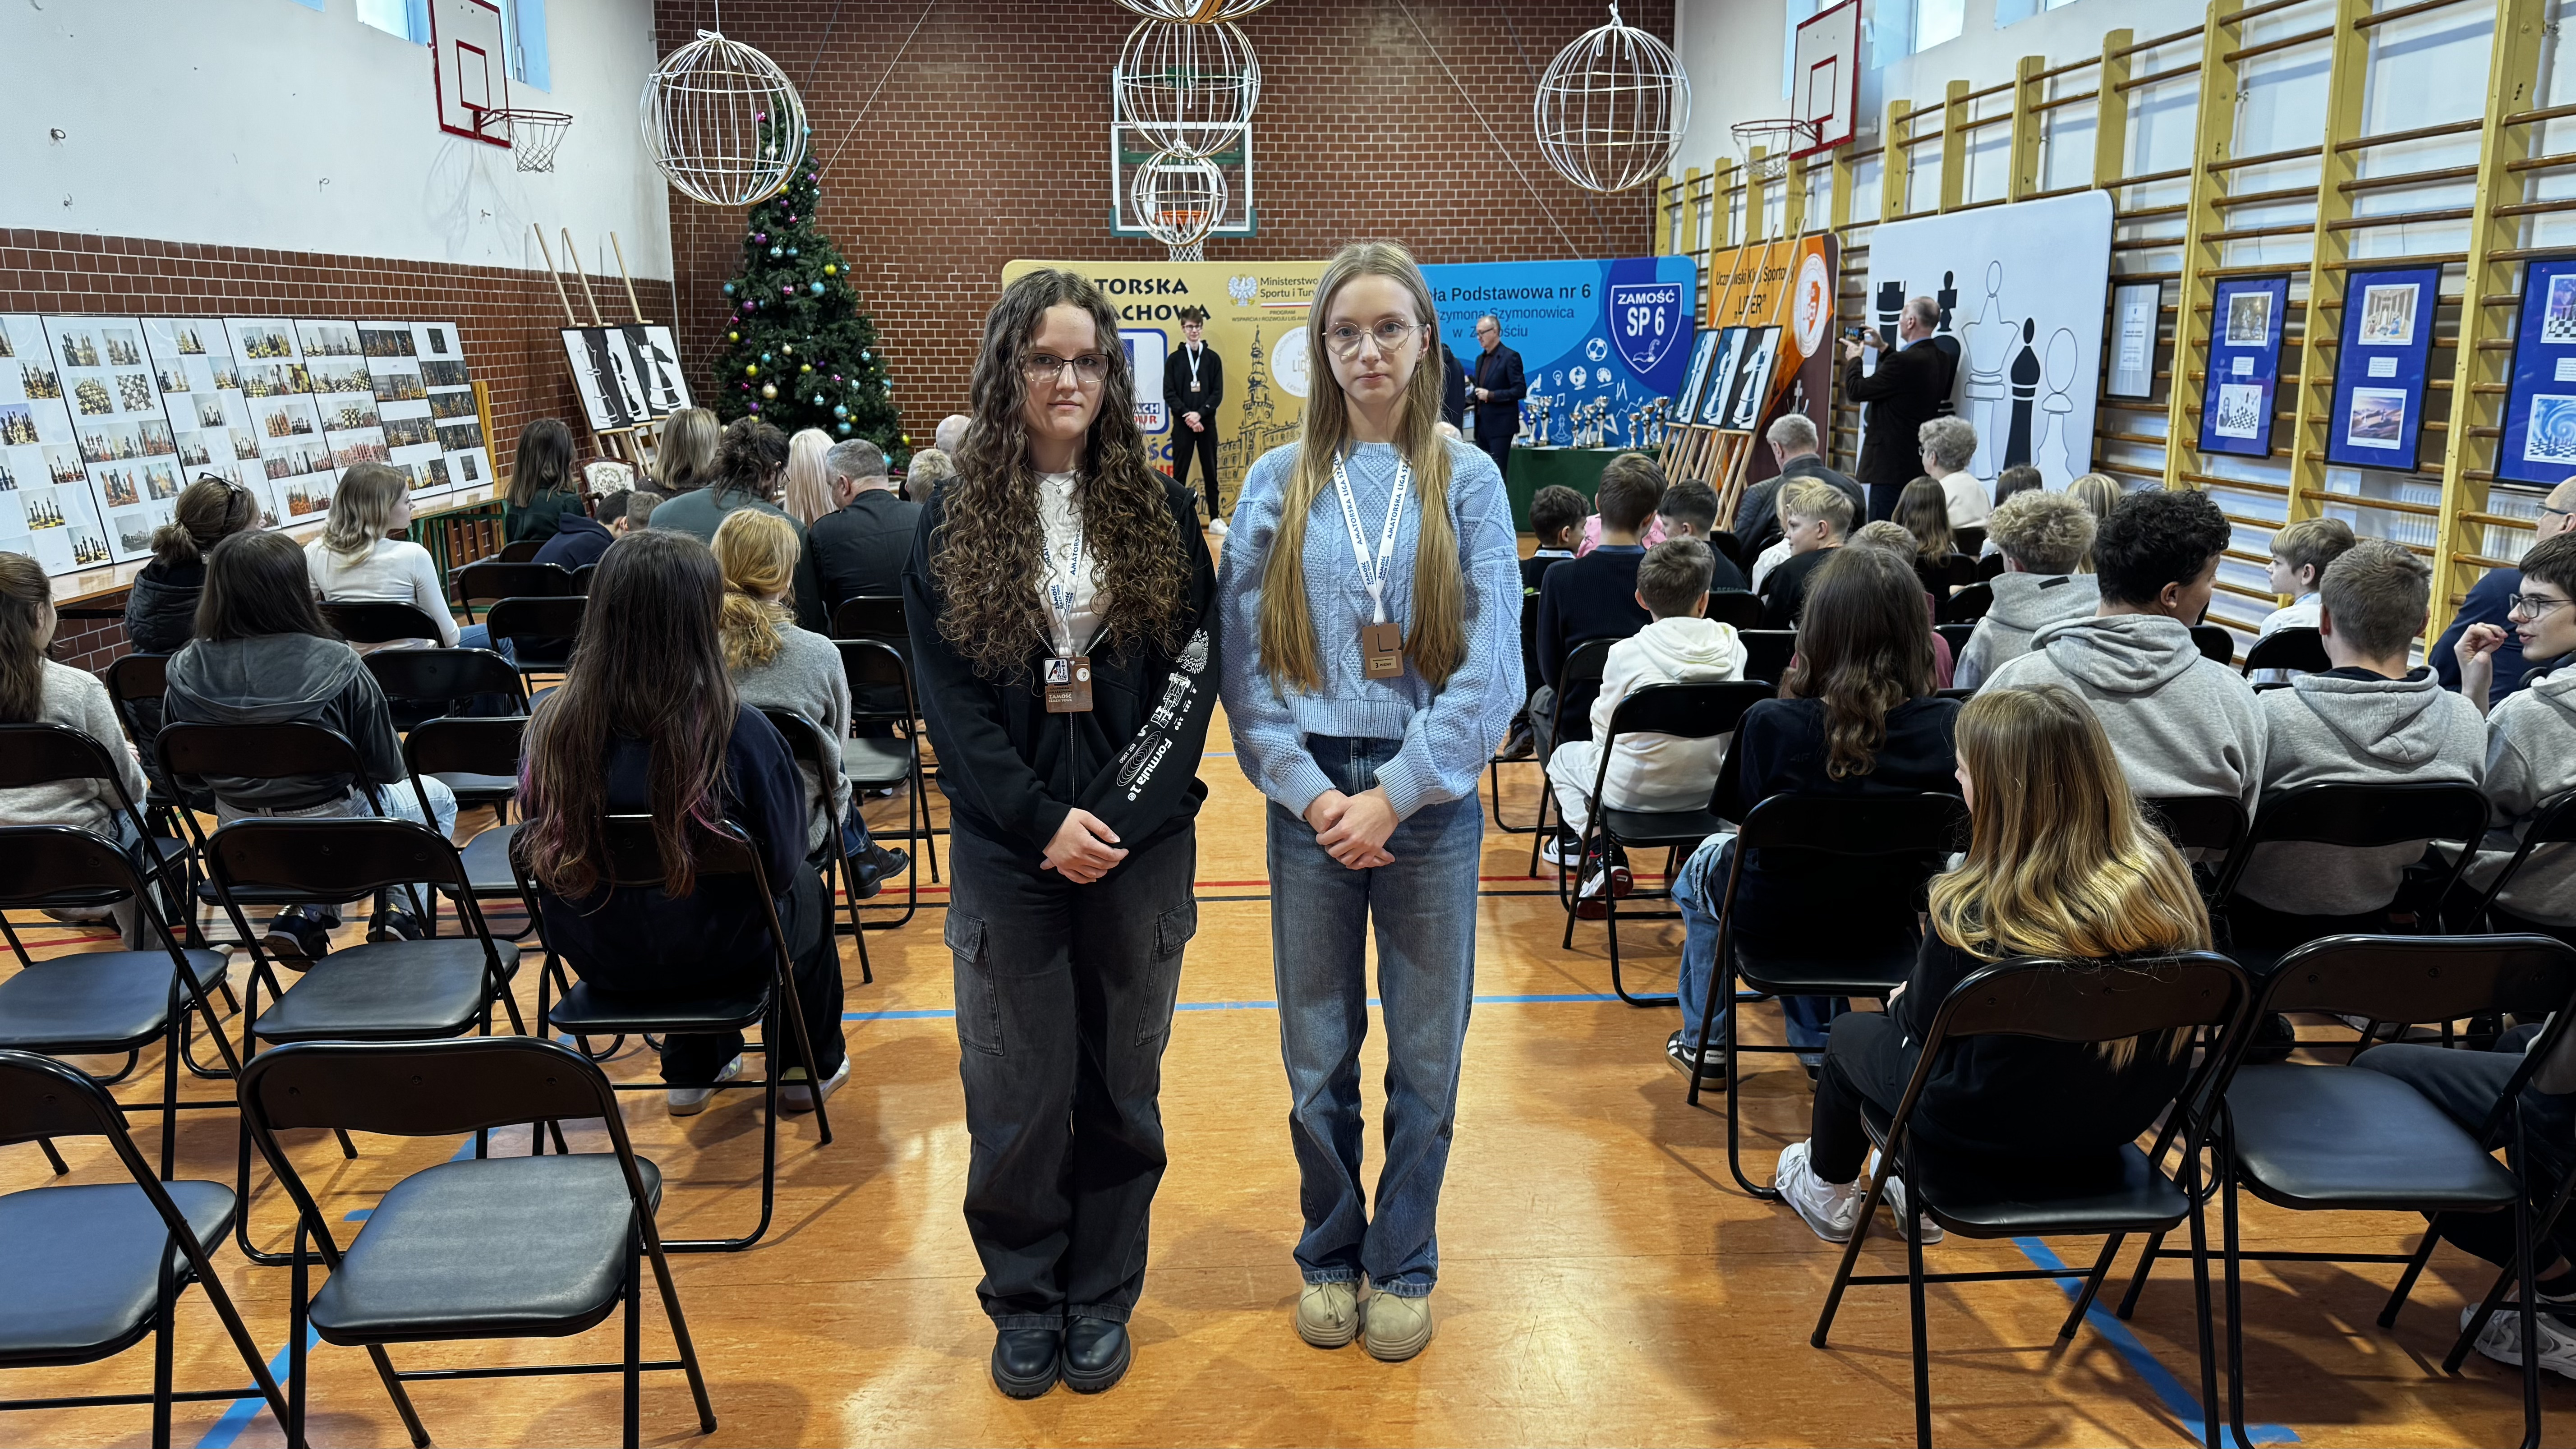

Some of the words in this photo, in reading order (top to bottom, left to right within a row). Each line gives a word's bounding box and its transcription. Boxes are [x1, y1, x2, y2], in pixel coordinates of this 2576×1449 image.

[1094, 277, 1189, 294] TORSKA
[1260, 277, 1318, 286] Ministerstwo
[1260, 289, 1290, 298] Sportu
[1293, 289, 1295, 297] i
[1452, 286, 1554, 301] Podstawowa
[1559, 286, 1576, 299] nr
[1581, 284, 1591, 298] 6
[1617, 289, 1675, 304] ZAMOŚĆ
[1121, 303, 1211, 321] CHOWA
[1490, 307, 1574, 322] Szymonowica
[1626, 307, 1651, 336] SP
[1654, 306, 1665, 336] 6
[1452, 328, 1463, 338] w
[1341, 480, 1349, 496] LIGA
[1387, 493, 1402, 539] AMATORSKA
[1397, 474, 1406, 491] LIGA
[1346, 499, 1362, 545] AMATORSKA
[1360, 561, 1371, 586] ZAMOŚĆ
[1127, 743, 1136, 753] EST.
[1119, 751, 1130, 764] 1950
[1136, 738, 1173, 785] Formula
